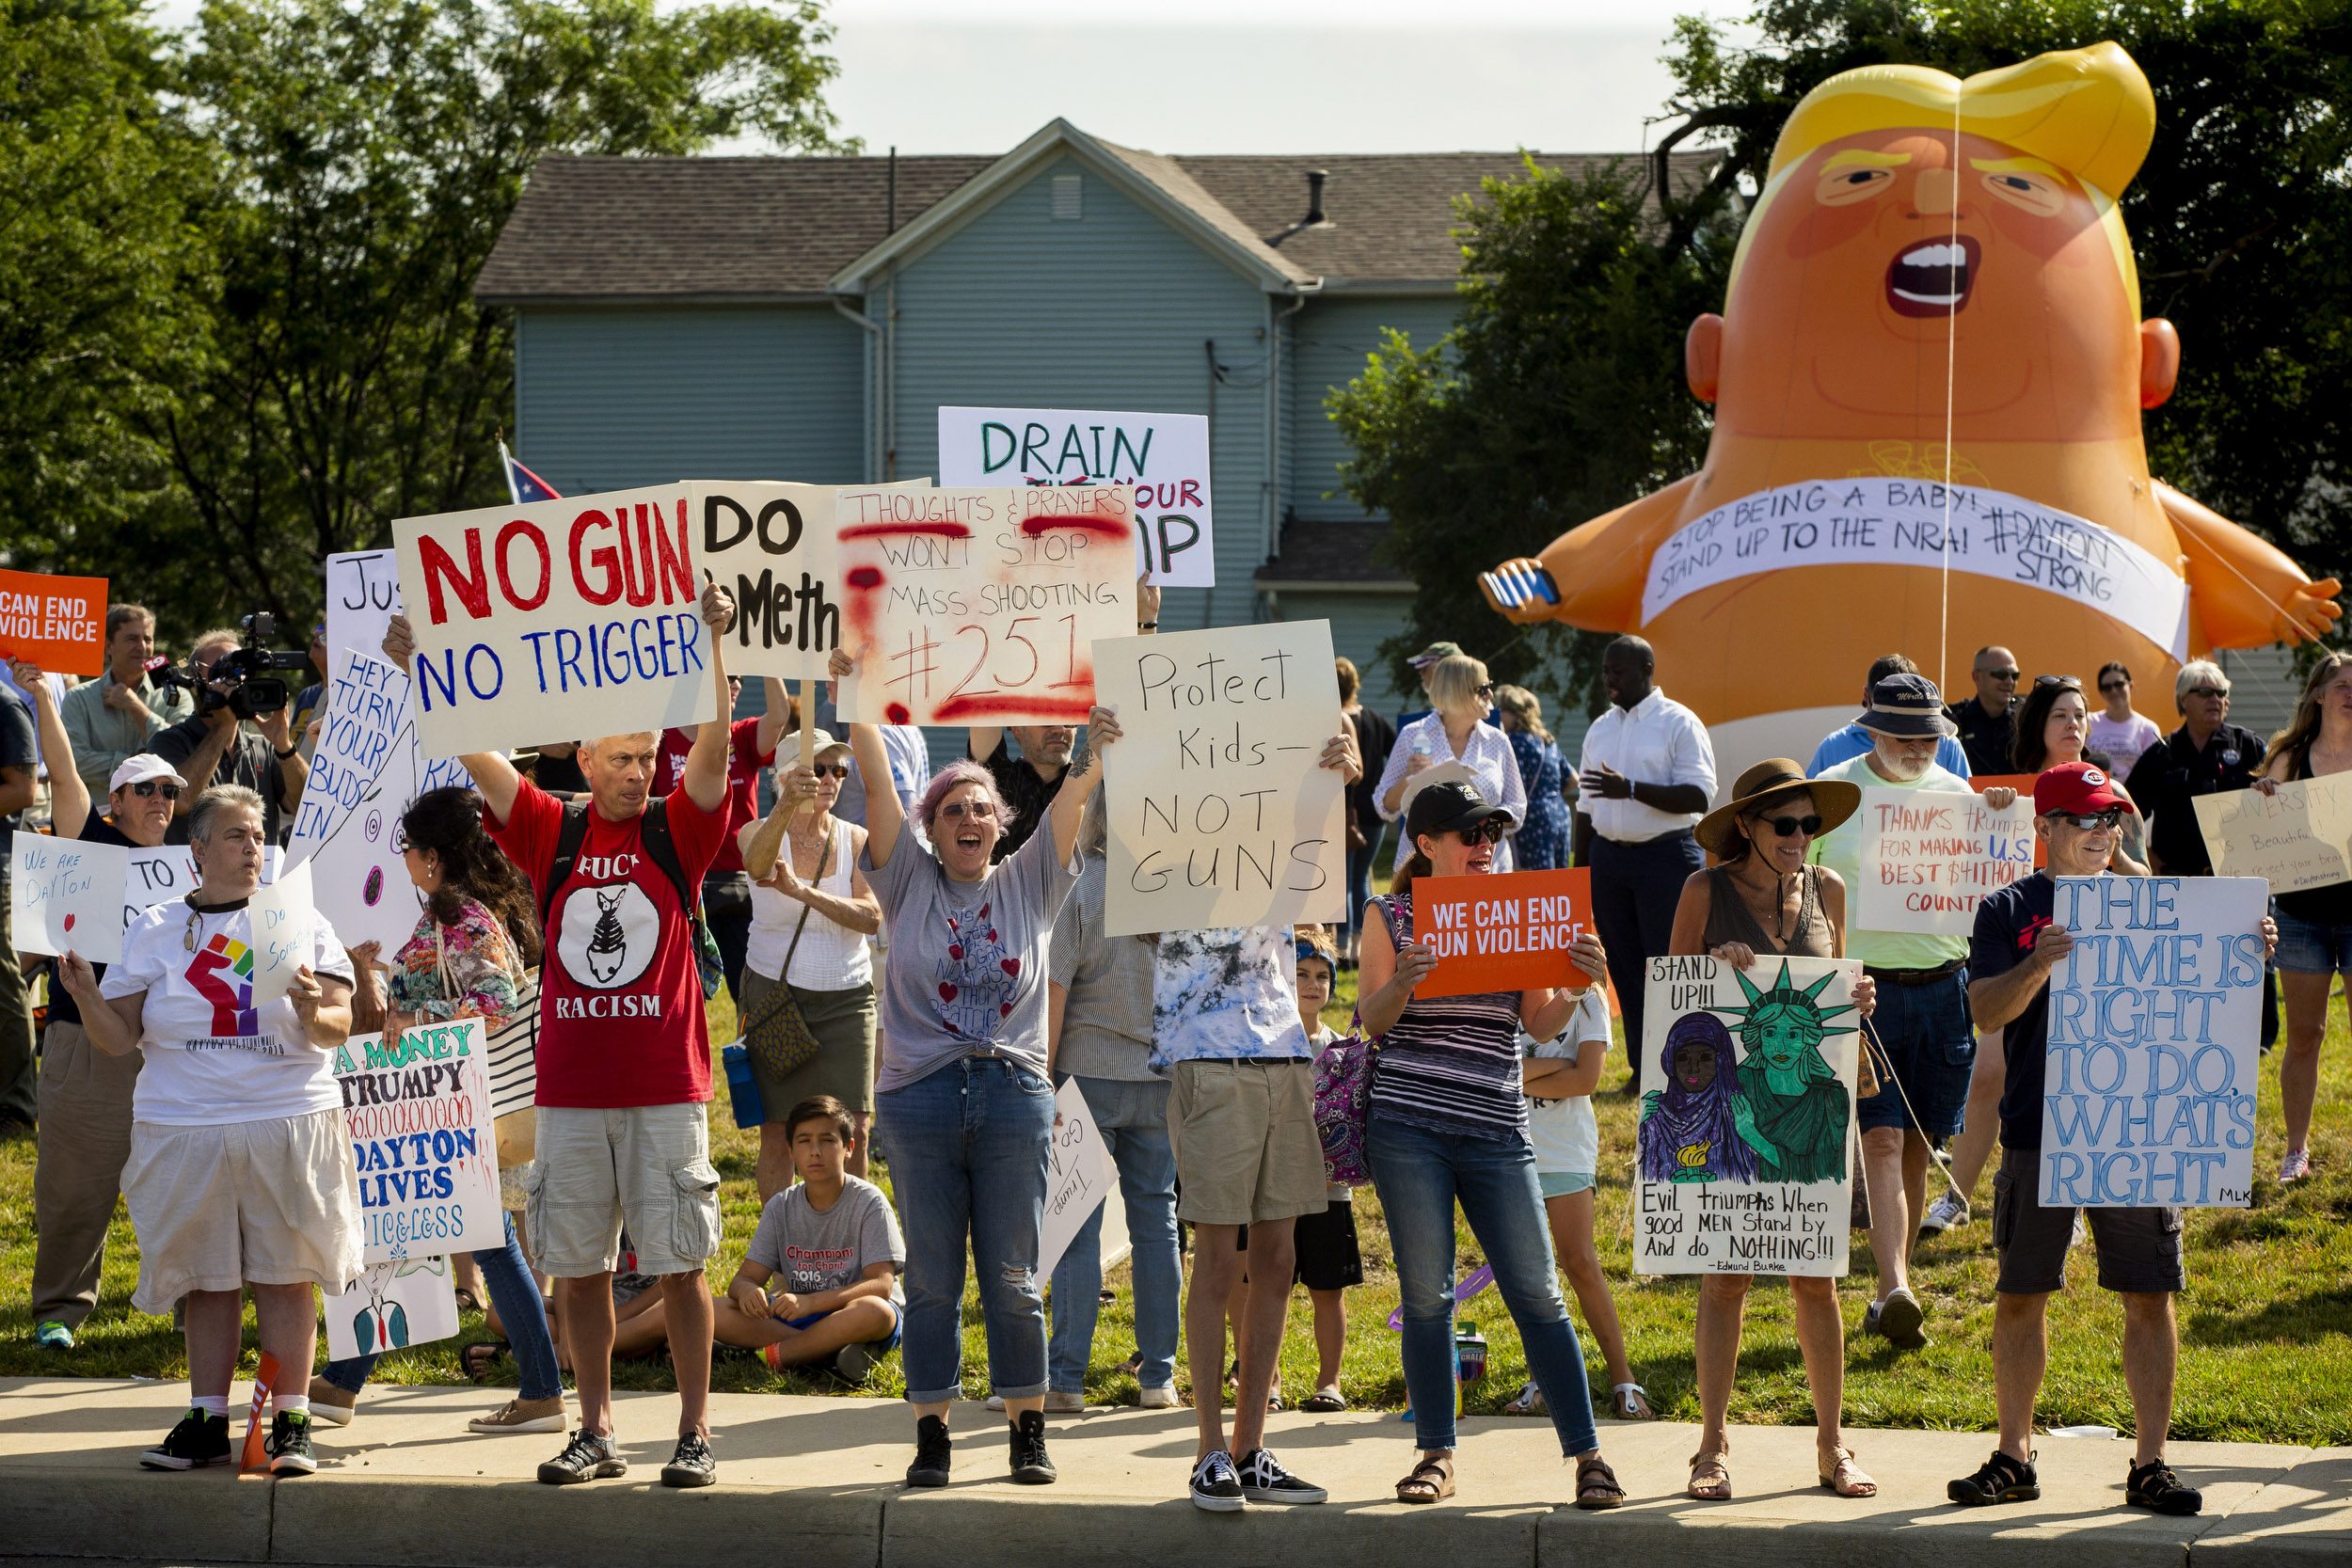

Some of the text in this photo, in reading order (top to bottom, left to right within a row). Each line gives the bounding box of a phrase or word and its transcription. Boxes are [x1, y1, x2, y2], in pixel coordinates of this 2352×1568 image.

[981, 420, 1153, 479] DRAIN
[844, 492, 994, 523] THOUGHTS
[1025, 488, 1127, 517] PRAYERS
[1114, 477, 1204, 509] OUR
[705, 495, 803, 556] DO
[1669, 482, 1976, 560] STOP BEING A BABY!
[1981, 505, 2109, 569] #DAYTON
[417, 497, 697, 626] NO GUN
[996, 532, 1089, 565] STOP
[1657, 517, 1968, 600] STAND UP TO THE NRA!
[2016, 548, 2113, 603] STRONG
[0, 591, 87, 620] CAN END
[887, 581, 1120, 617] MASS SHOOTING
[0, 614, 98, 643] VIOLENCE
[145, 656, 166, 670] 19
[348, 654, 395, 693] HEY
[417, 613, 704, 713] NO TRIGGER
[884, 613, 1094, 705] #251
[1138, 649, 1293, 711] Protect
[336, 678, 405, 737] TURN
[326, 710, 388, 778] YOUR
[308, 753, 372, 811] BUDS
[294, 801, 335, 840] IN
[1142, 789, 1278, 836] NOT
[1874, 803, 1955, 832] THANKS
[2214, 784, 2336, 824] DIVERSITY
[24, 852, 83, 871] WE ARE
[1131, 839, 1328, 893] GUNS
[1881, 834, 2032, 863] FOR MAKING U.S.
[131, 859, 174, 891] TO
[1881, 863, 1942, 885] BEST
[1432, 895, 1571, 929] WE CAN END
[1906, 893, 1986, 913] COUNT
[2056, 878, 2181, 931] THE
[1422, 930, 1468, 958] GUN
[2066, 933, 2265, 989] TIME IS
[556, 994, 661, 1020] RACISM
[1671, 984, 1715, 1011] UP!!!
[2048, 987, 2227, 1049] RIGHT
[332, 1023, 475, 1076] A MONEY
[2047, 1041, 2126, 1096] TO
[339, 1059, 466, 1109] TRUMPY
[353, 1128, 477, 1173] DAYTON
[359, 1166, 454, 1208] LIVES
[2045, 1151, 2226, 1207] RIGHT
[2219, 1187, 2251, 1202] MLK
[1781, 1187, 1828, 1212] When
[1645, 1213, 1683, 1235] good
[1698, 1213, 1732, 1232] MEN
[1803, 1214, 1825, 1235] by
[787, 1245, 854, 1260] Champions
[798, 1260, 812, 1271] for
[1645, 1236, 1675, 1257] And
[1688, 1235, 1709, 1257] do
[792, 1270, 821, 1282] 2016
